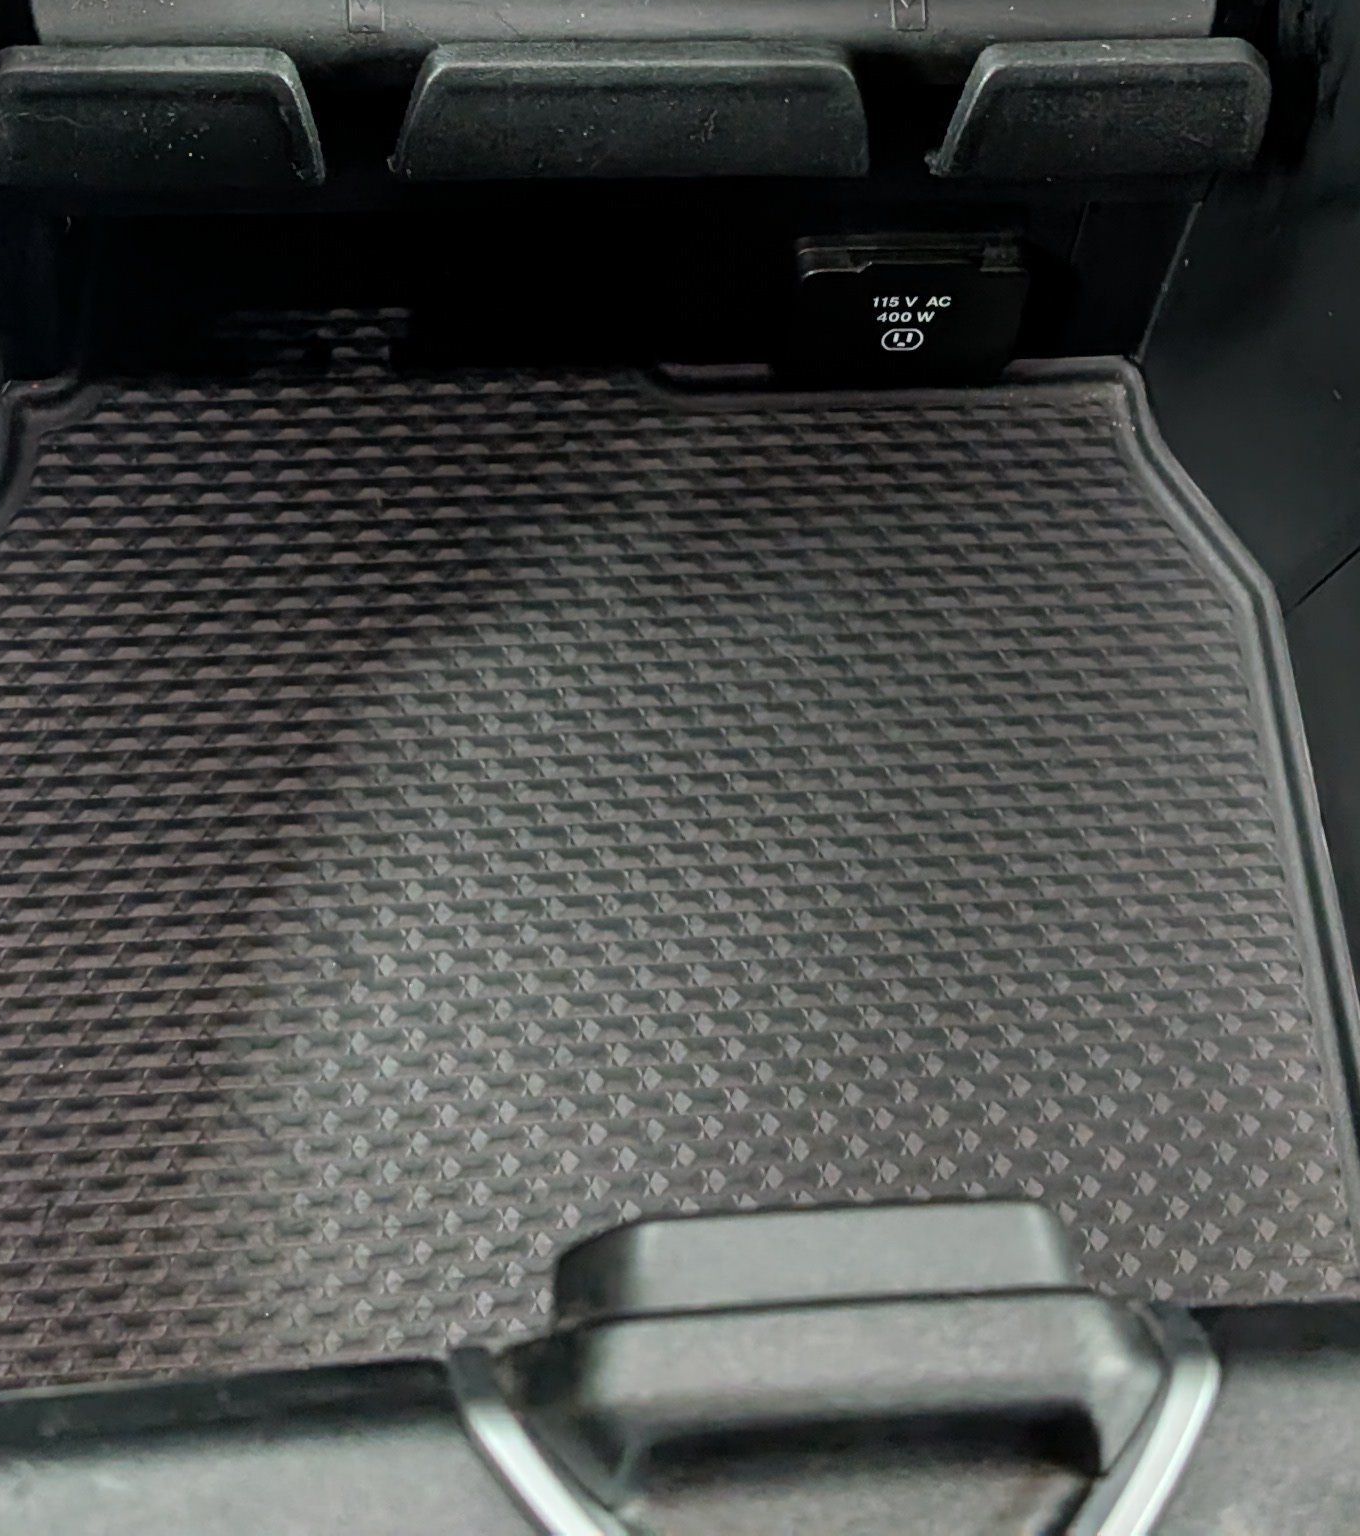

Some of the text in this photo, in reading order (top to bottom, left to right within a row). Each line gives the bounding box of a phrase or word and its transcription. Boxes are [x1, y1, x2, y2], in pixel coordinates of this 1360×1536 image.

[873, 296, 952, 308] 115 V AC
[877, 311, 936, 323] 400 W
